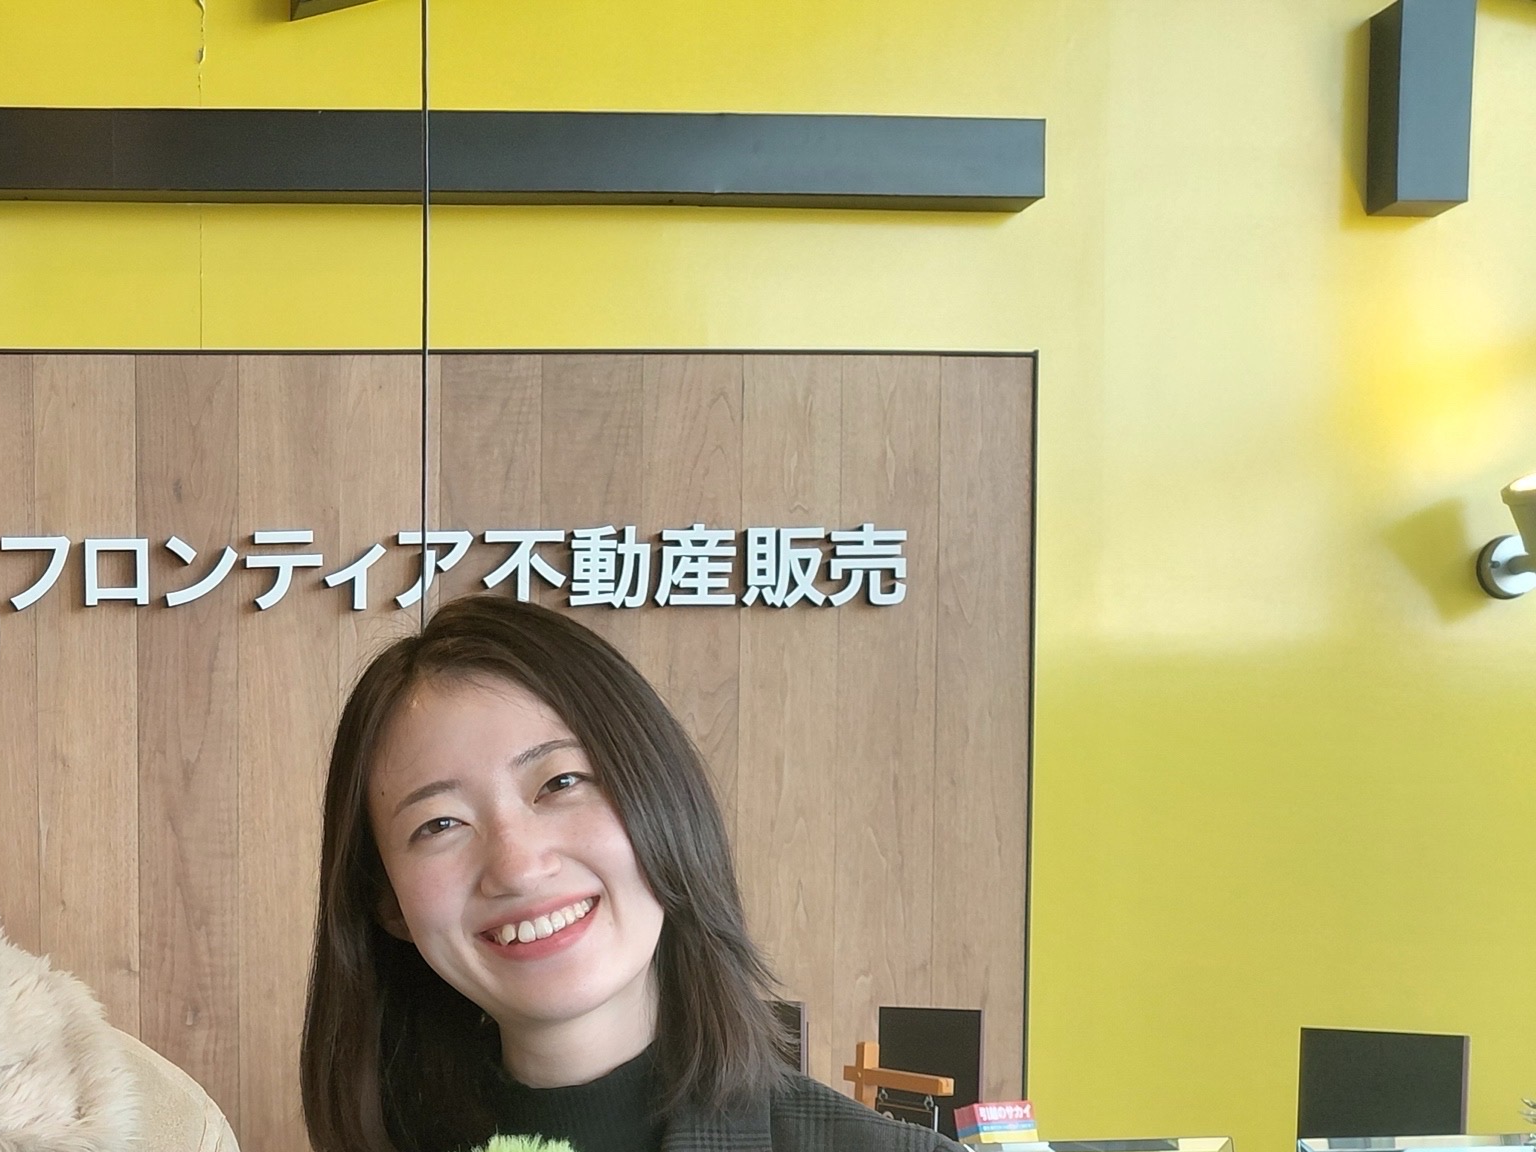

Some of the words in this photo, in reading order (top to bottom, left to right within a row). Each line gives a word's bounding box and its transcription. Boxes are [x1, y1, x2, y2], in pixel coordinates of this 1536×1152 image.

[0, 524, 908, 611] フロンティア不動産販売
